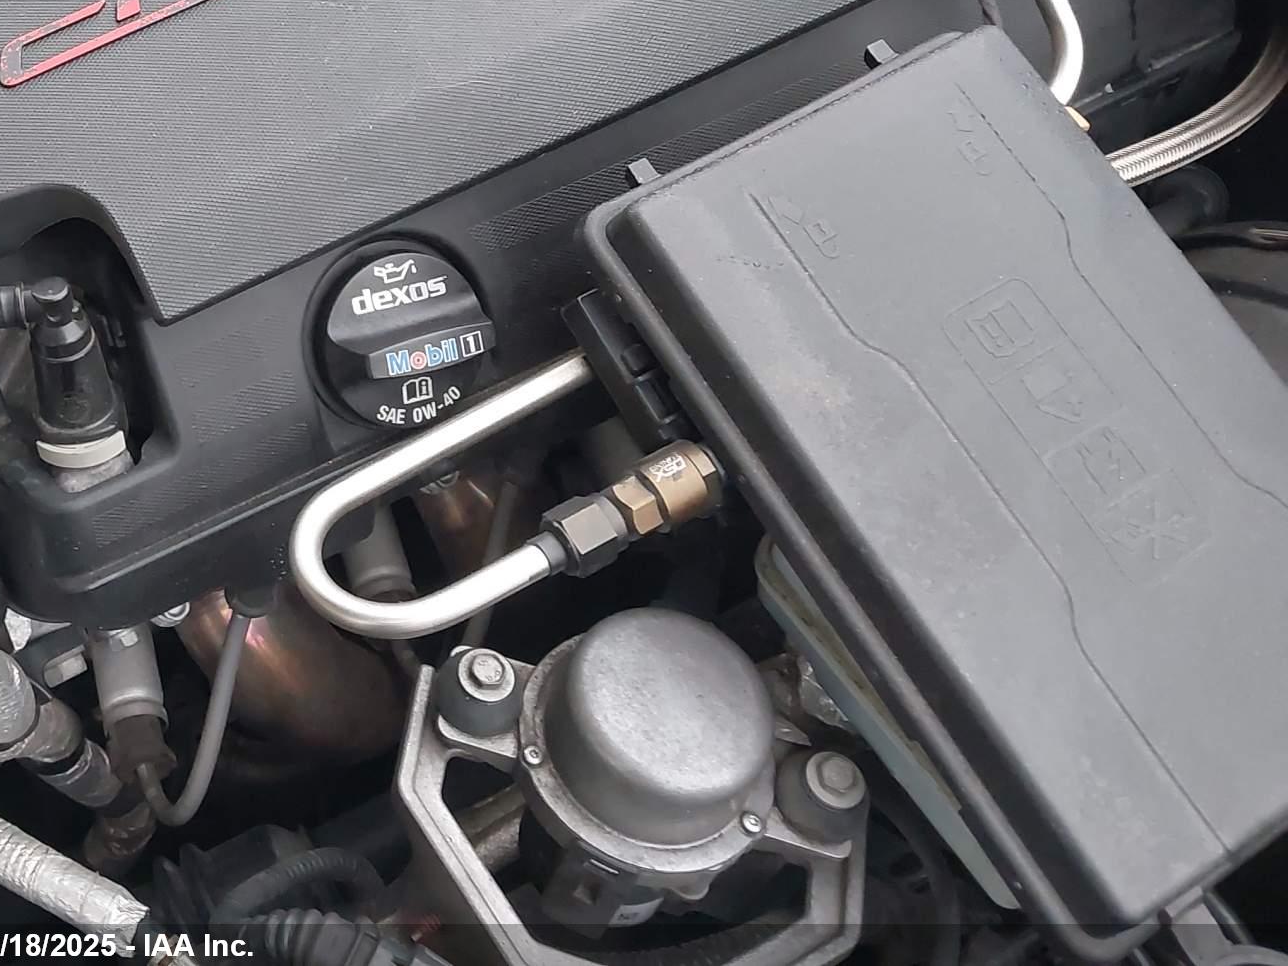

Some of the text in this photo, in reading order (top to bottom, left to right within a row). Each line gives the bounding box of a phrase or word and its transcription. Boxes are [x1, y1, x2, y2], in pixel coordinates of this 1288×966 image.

[351, 277, 447, 315] dexos
[386, 338, 458, 376] Mobil
[376, 386, 461, 424] SAE 0W-40
